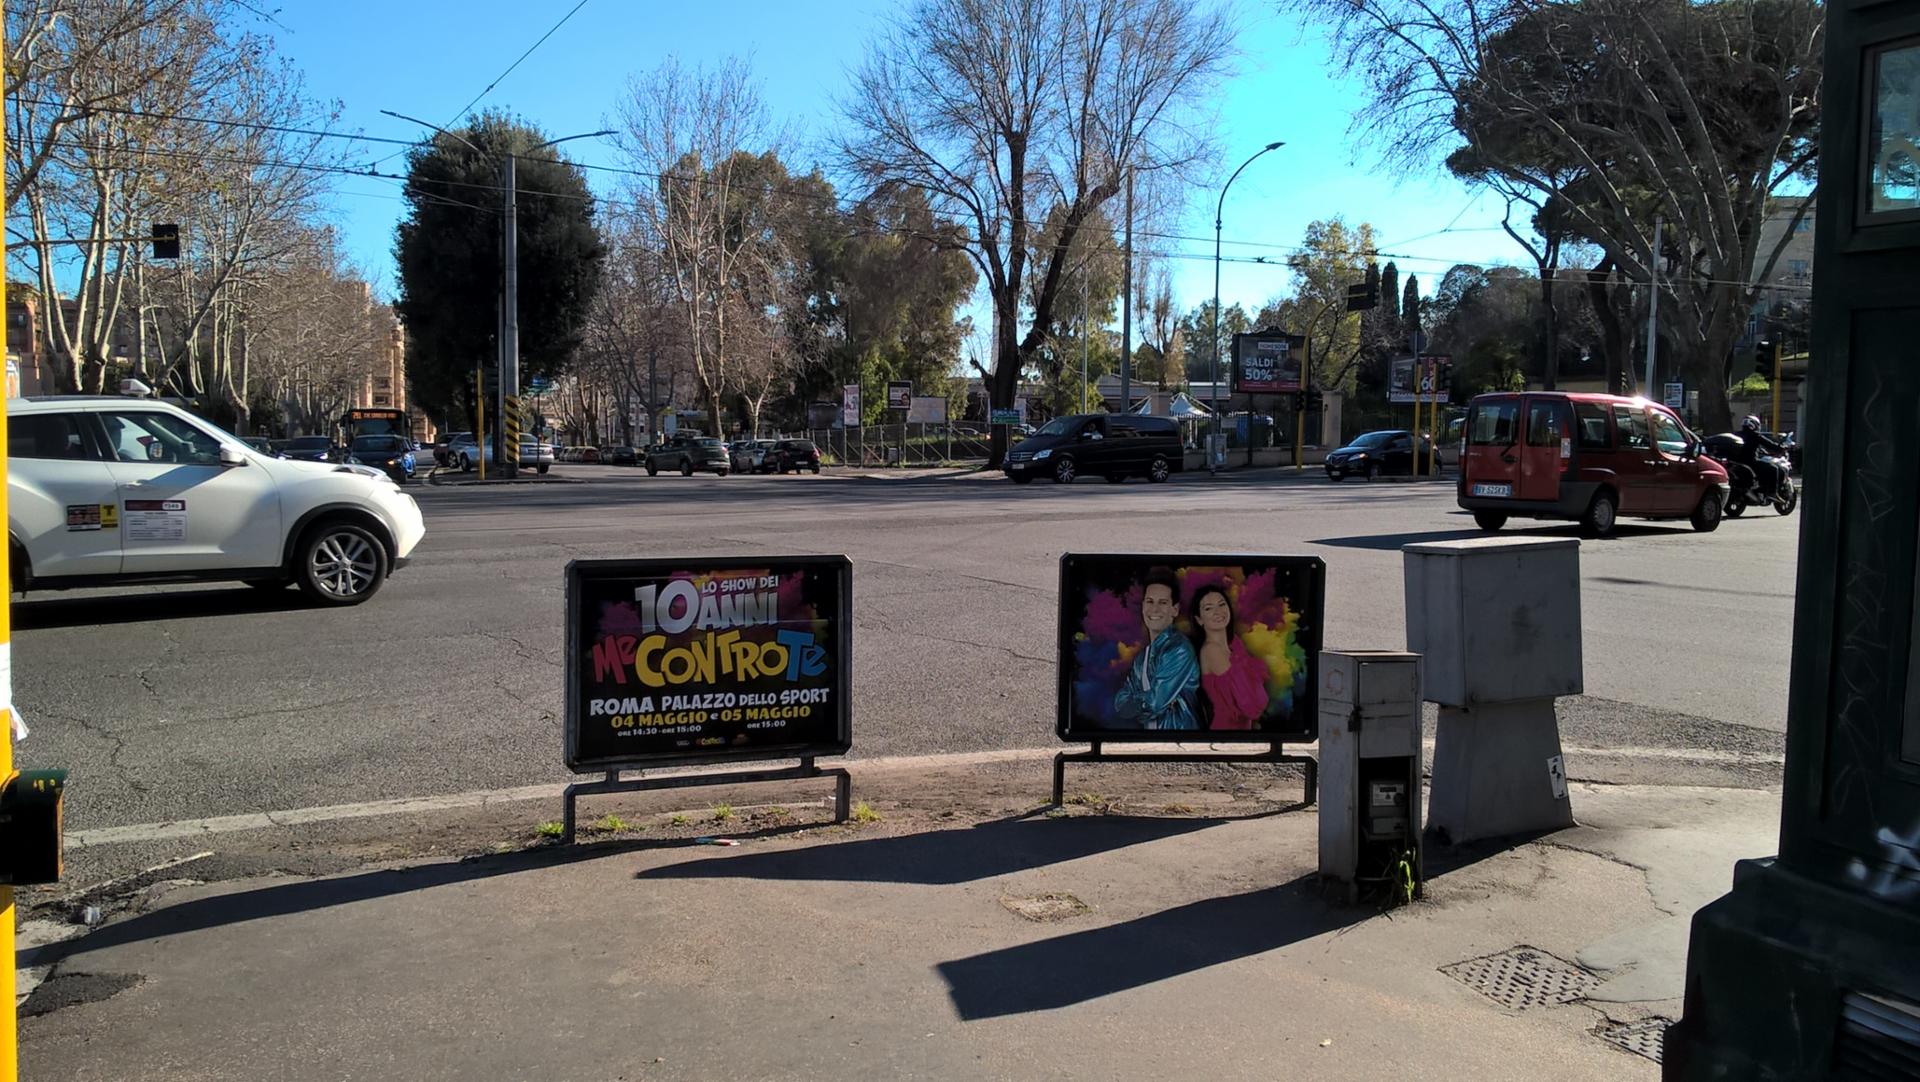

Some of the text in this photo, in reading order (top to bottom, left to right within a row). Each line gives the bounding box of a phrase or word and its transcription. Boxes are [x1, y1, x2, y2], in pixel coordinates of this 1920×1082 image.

[1246, 357, 1274, 368] SALDI
[1245, 368, 1273, 381] 50%
[701, 575, 779, 594] LO SHOW DEI
[634, 579, 700, 634] 10
[696, 591, 779, 630] ANNI
[590, 687, 830, 716] ROMA PALAZZO DELLO SPORT
[610, 714, 635, 728] 04
[638, 710, 708, 727] MAGGIO
[720, 709, 742, 722] 05
[746, 705, 811, 720] MAGGIO
[762, 720, 786, 728] 15:00
[633, 728, 657, 736] 14:30
